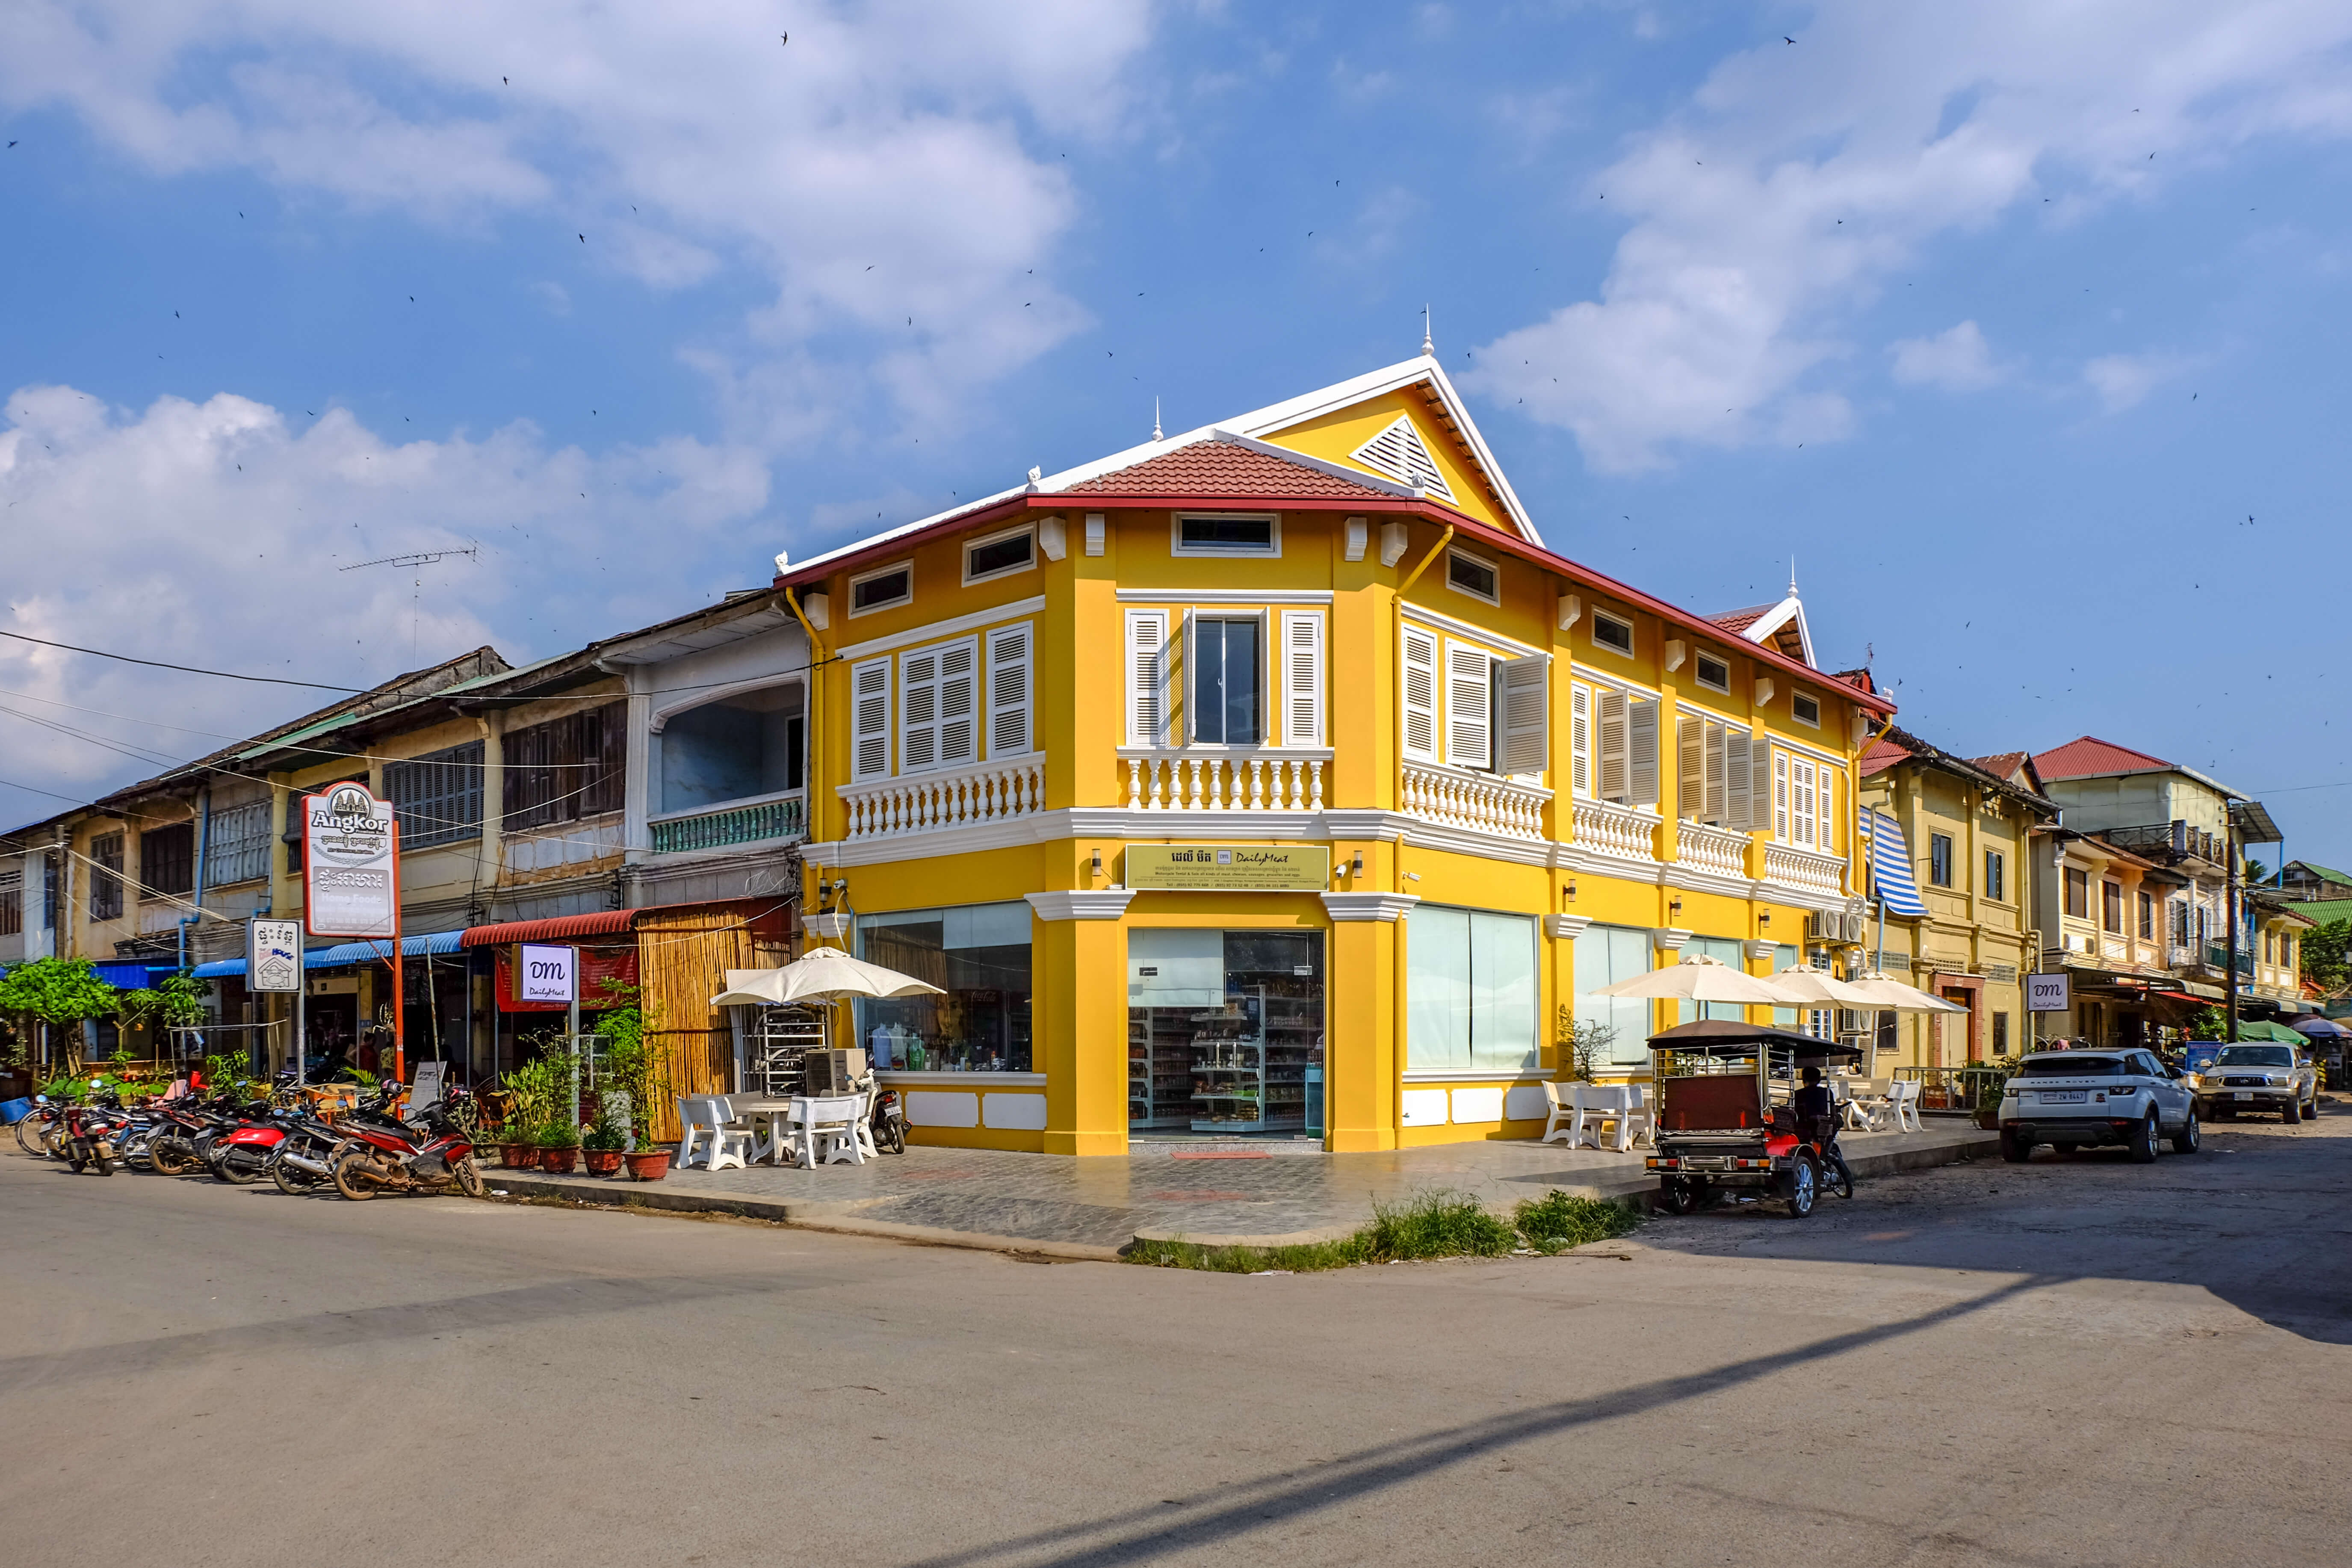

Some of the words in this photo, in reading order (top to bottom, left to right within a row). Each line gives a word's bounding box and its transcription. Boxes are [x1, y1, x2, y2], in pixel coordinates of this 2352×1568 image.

[312, 810, 389, 833] Angkor
[1236, 852, 1288, 866] DailyMeat
[322, 893, 350, 903] Home
[272, 948, 294, 960] HOUSE
[530, 961, 565, 980] DM
[529, 987, 565, 998] DailyMeat
[2034, 984, 2062, 996] DM
